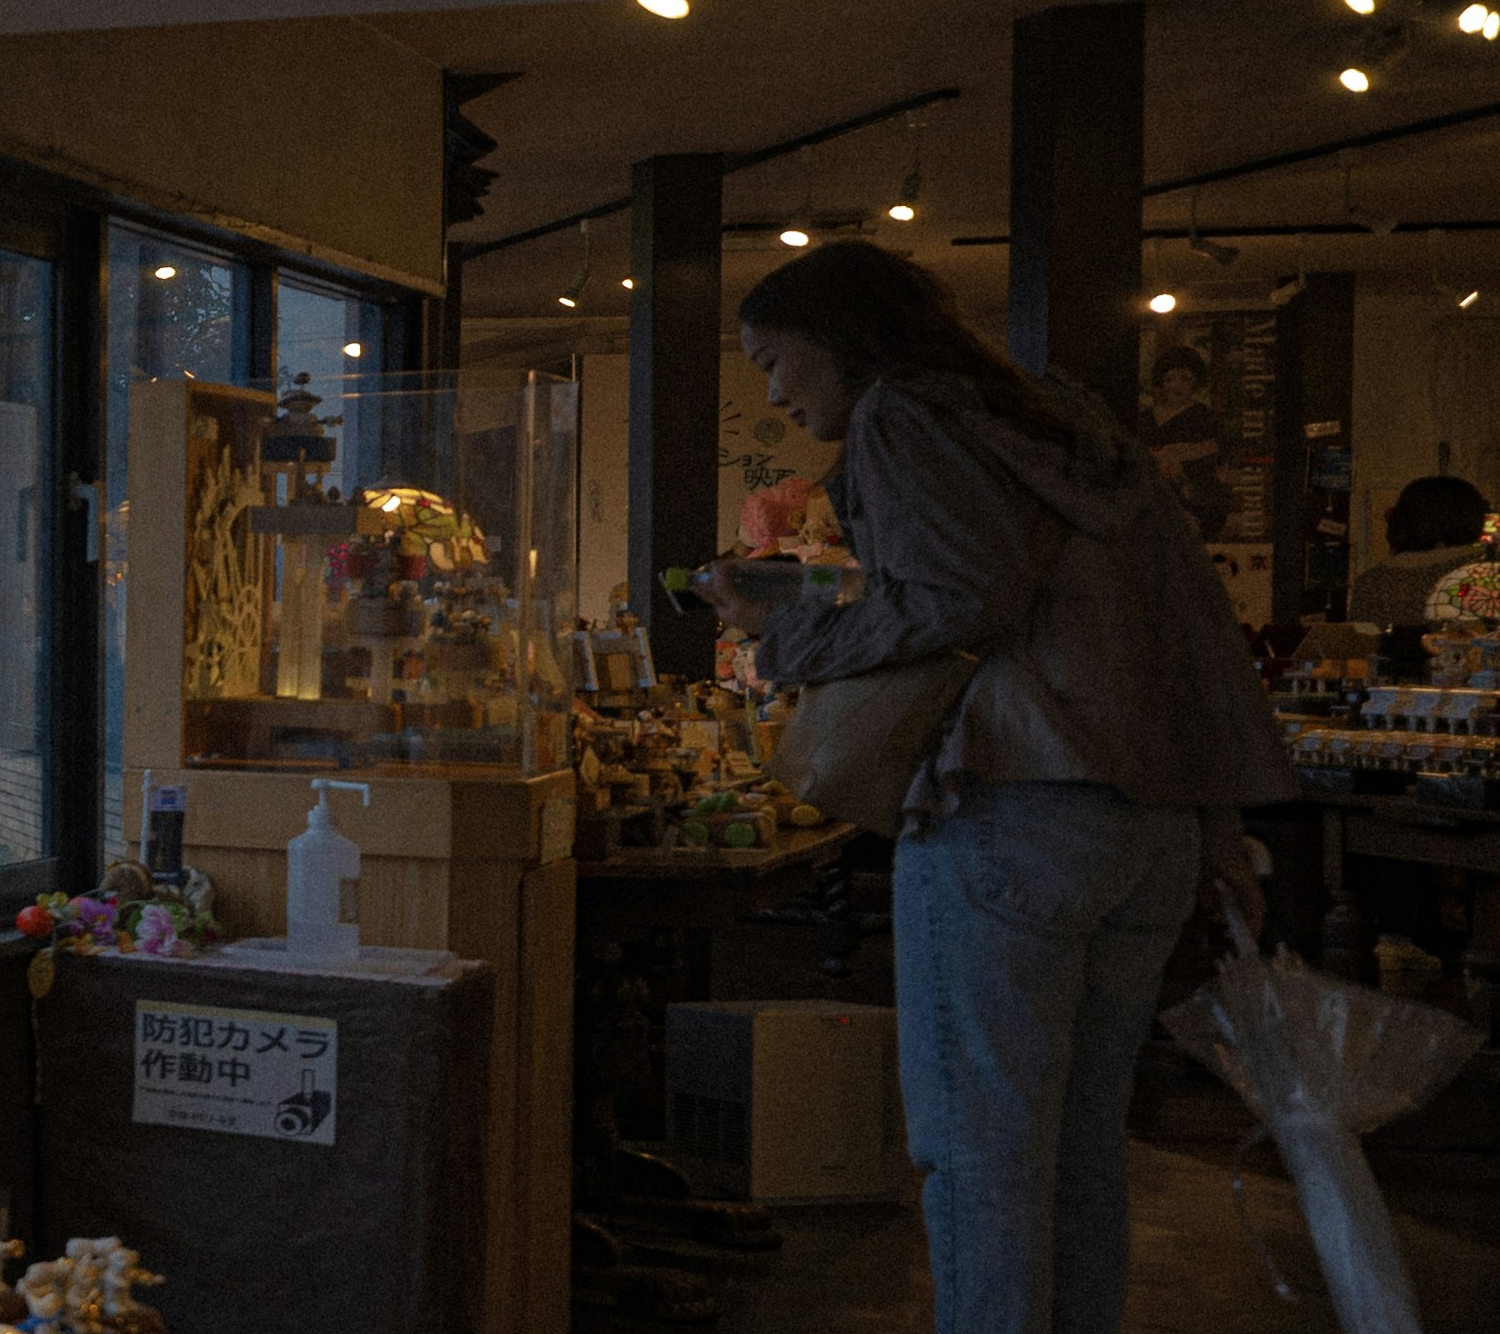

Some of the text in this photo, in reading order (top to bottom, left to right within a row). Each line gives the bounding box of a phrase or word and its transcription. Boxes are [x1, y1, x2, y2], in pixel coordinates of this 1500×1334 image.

[1232, 317, 1277, 537] Made in Japan
[141, 1013, 330, 1060] 防犯カメラ
[140, 1048, 251, 1087] 作動中
